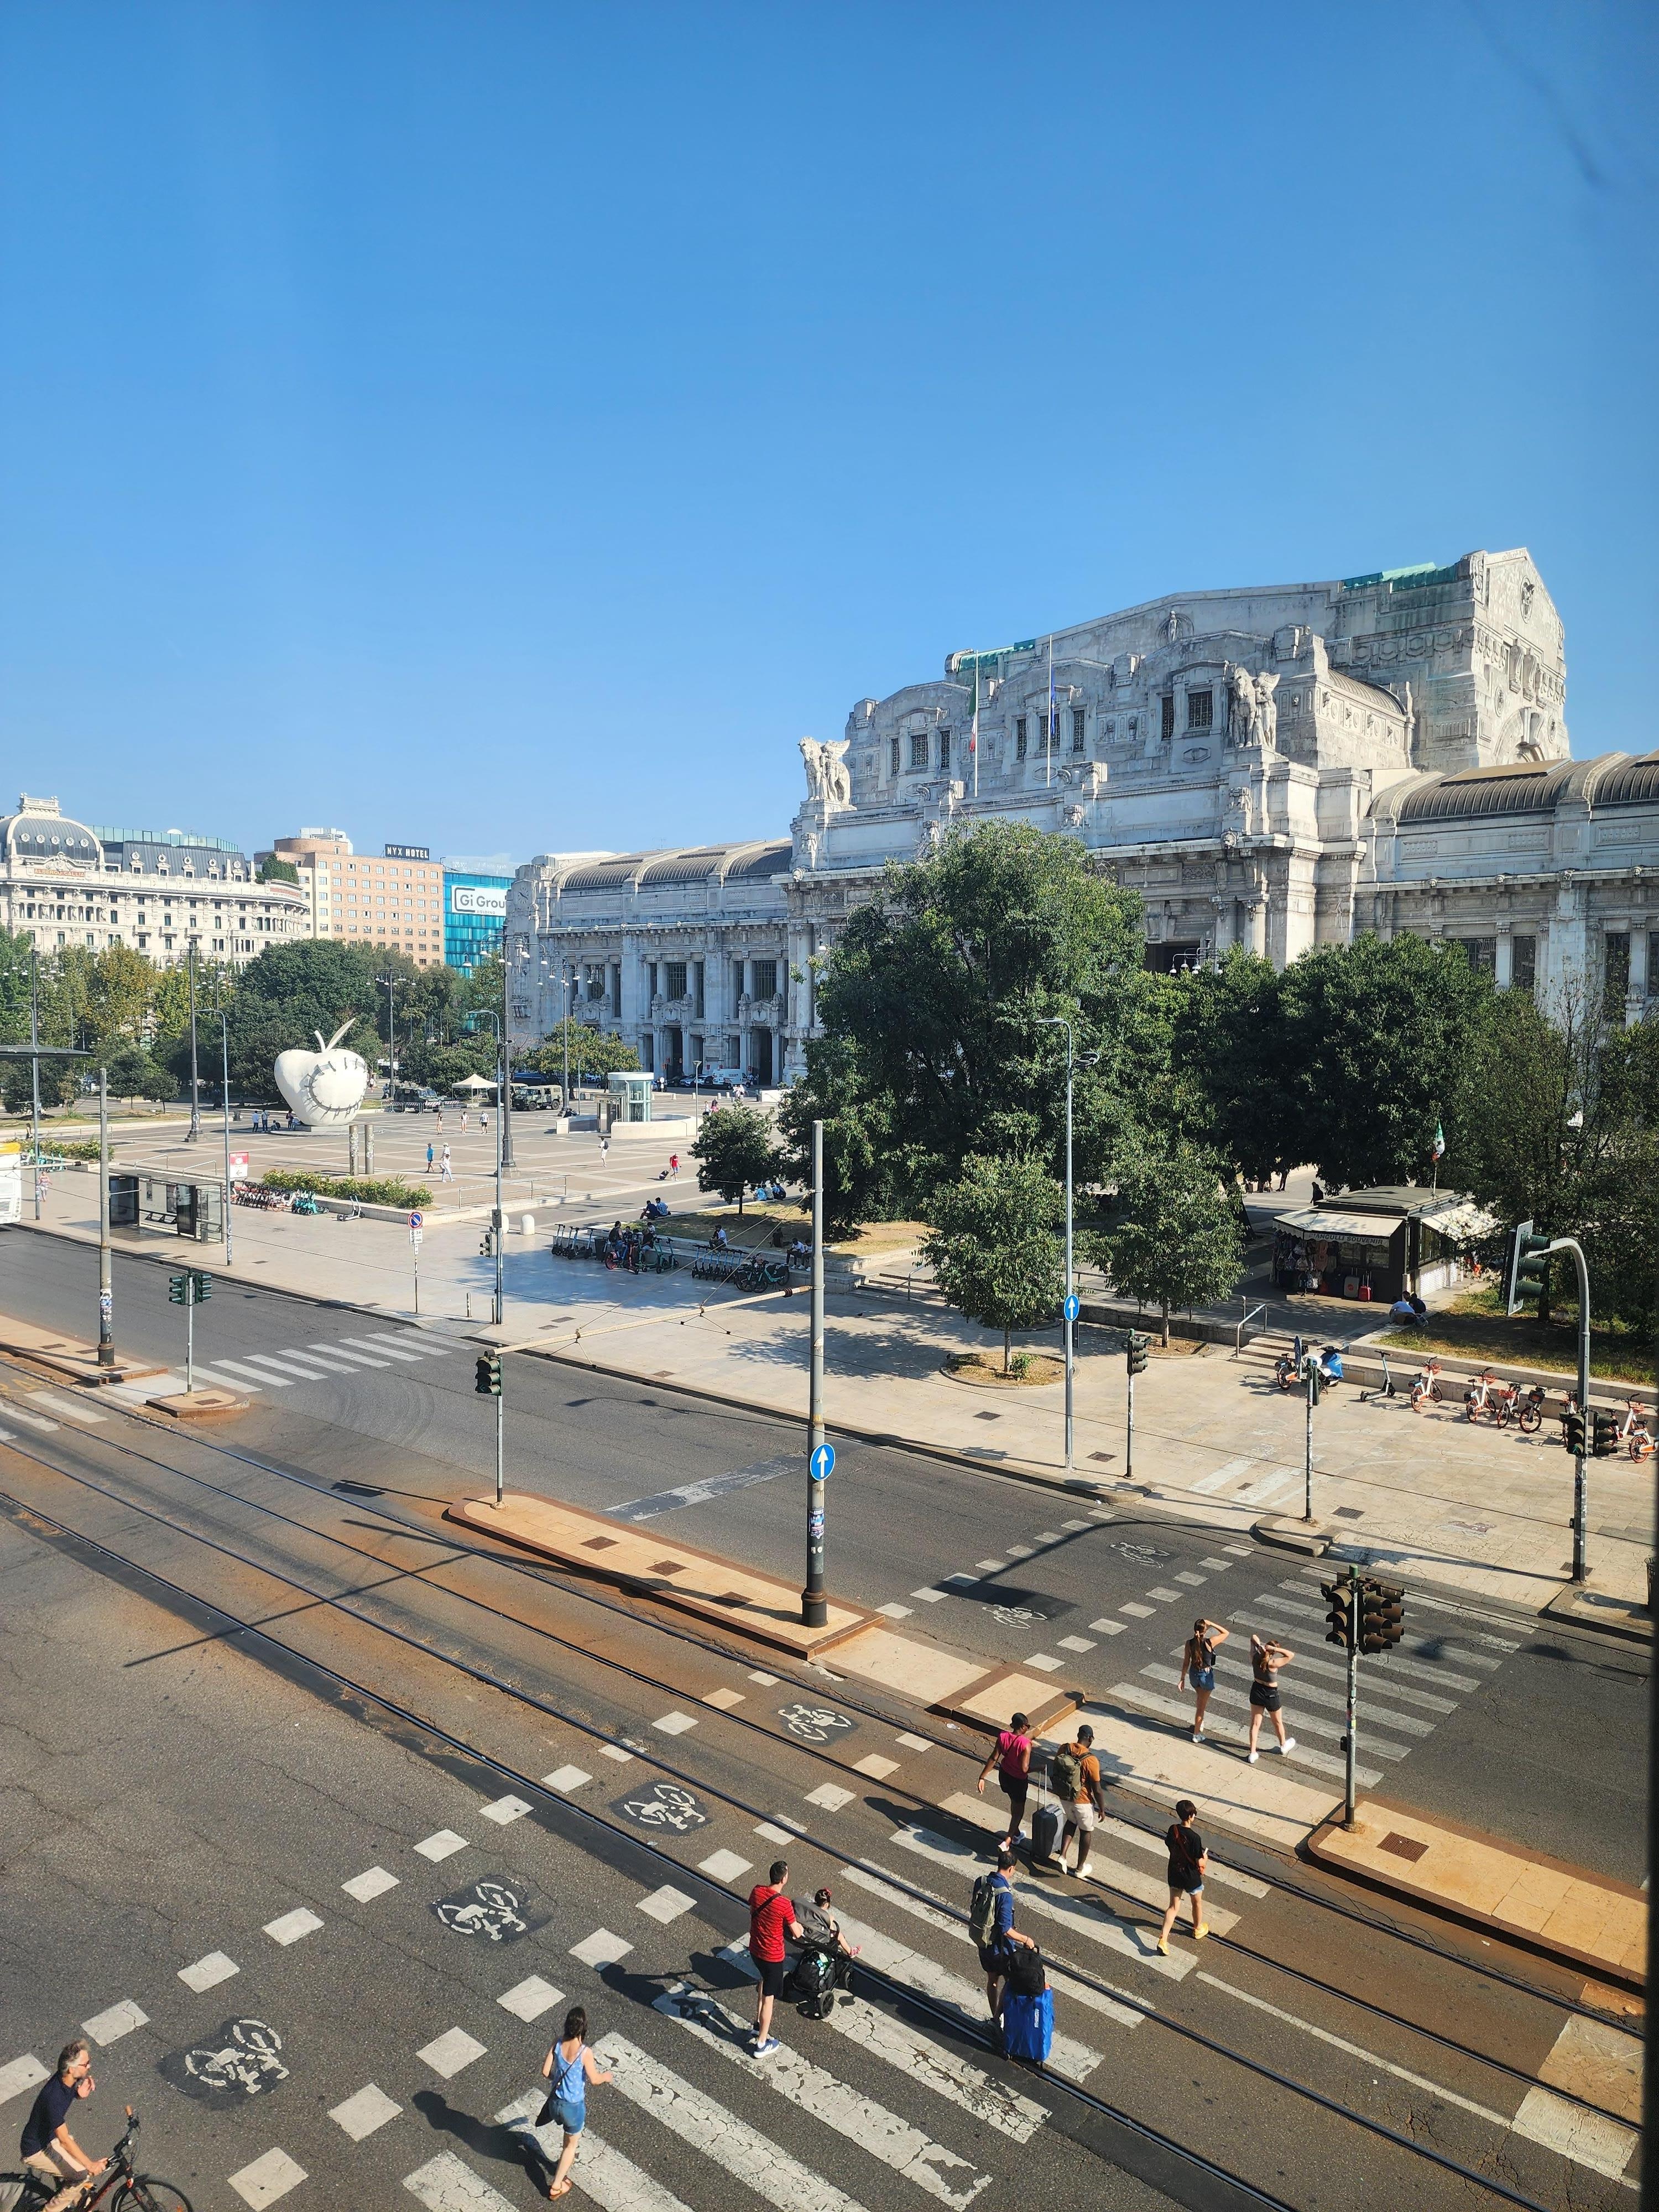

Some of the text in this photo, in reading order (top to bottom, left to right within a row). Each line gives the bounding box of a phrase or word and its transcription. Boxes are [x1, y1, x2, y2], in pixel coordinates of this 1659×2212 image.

[387, 846, 429, 858] NYX HOTEL
[460, 894, 473, 906] Gi
[1347, 1235, 1383, 1244] SOUVENIR
